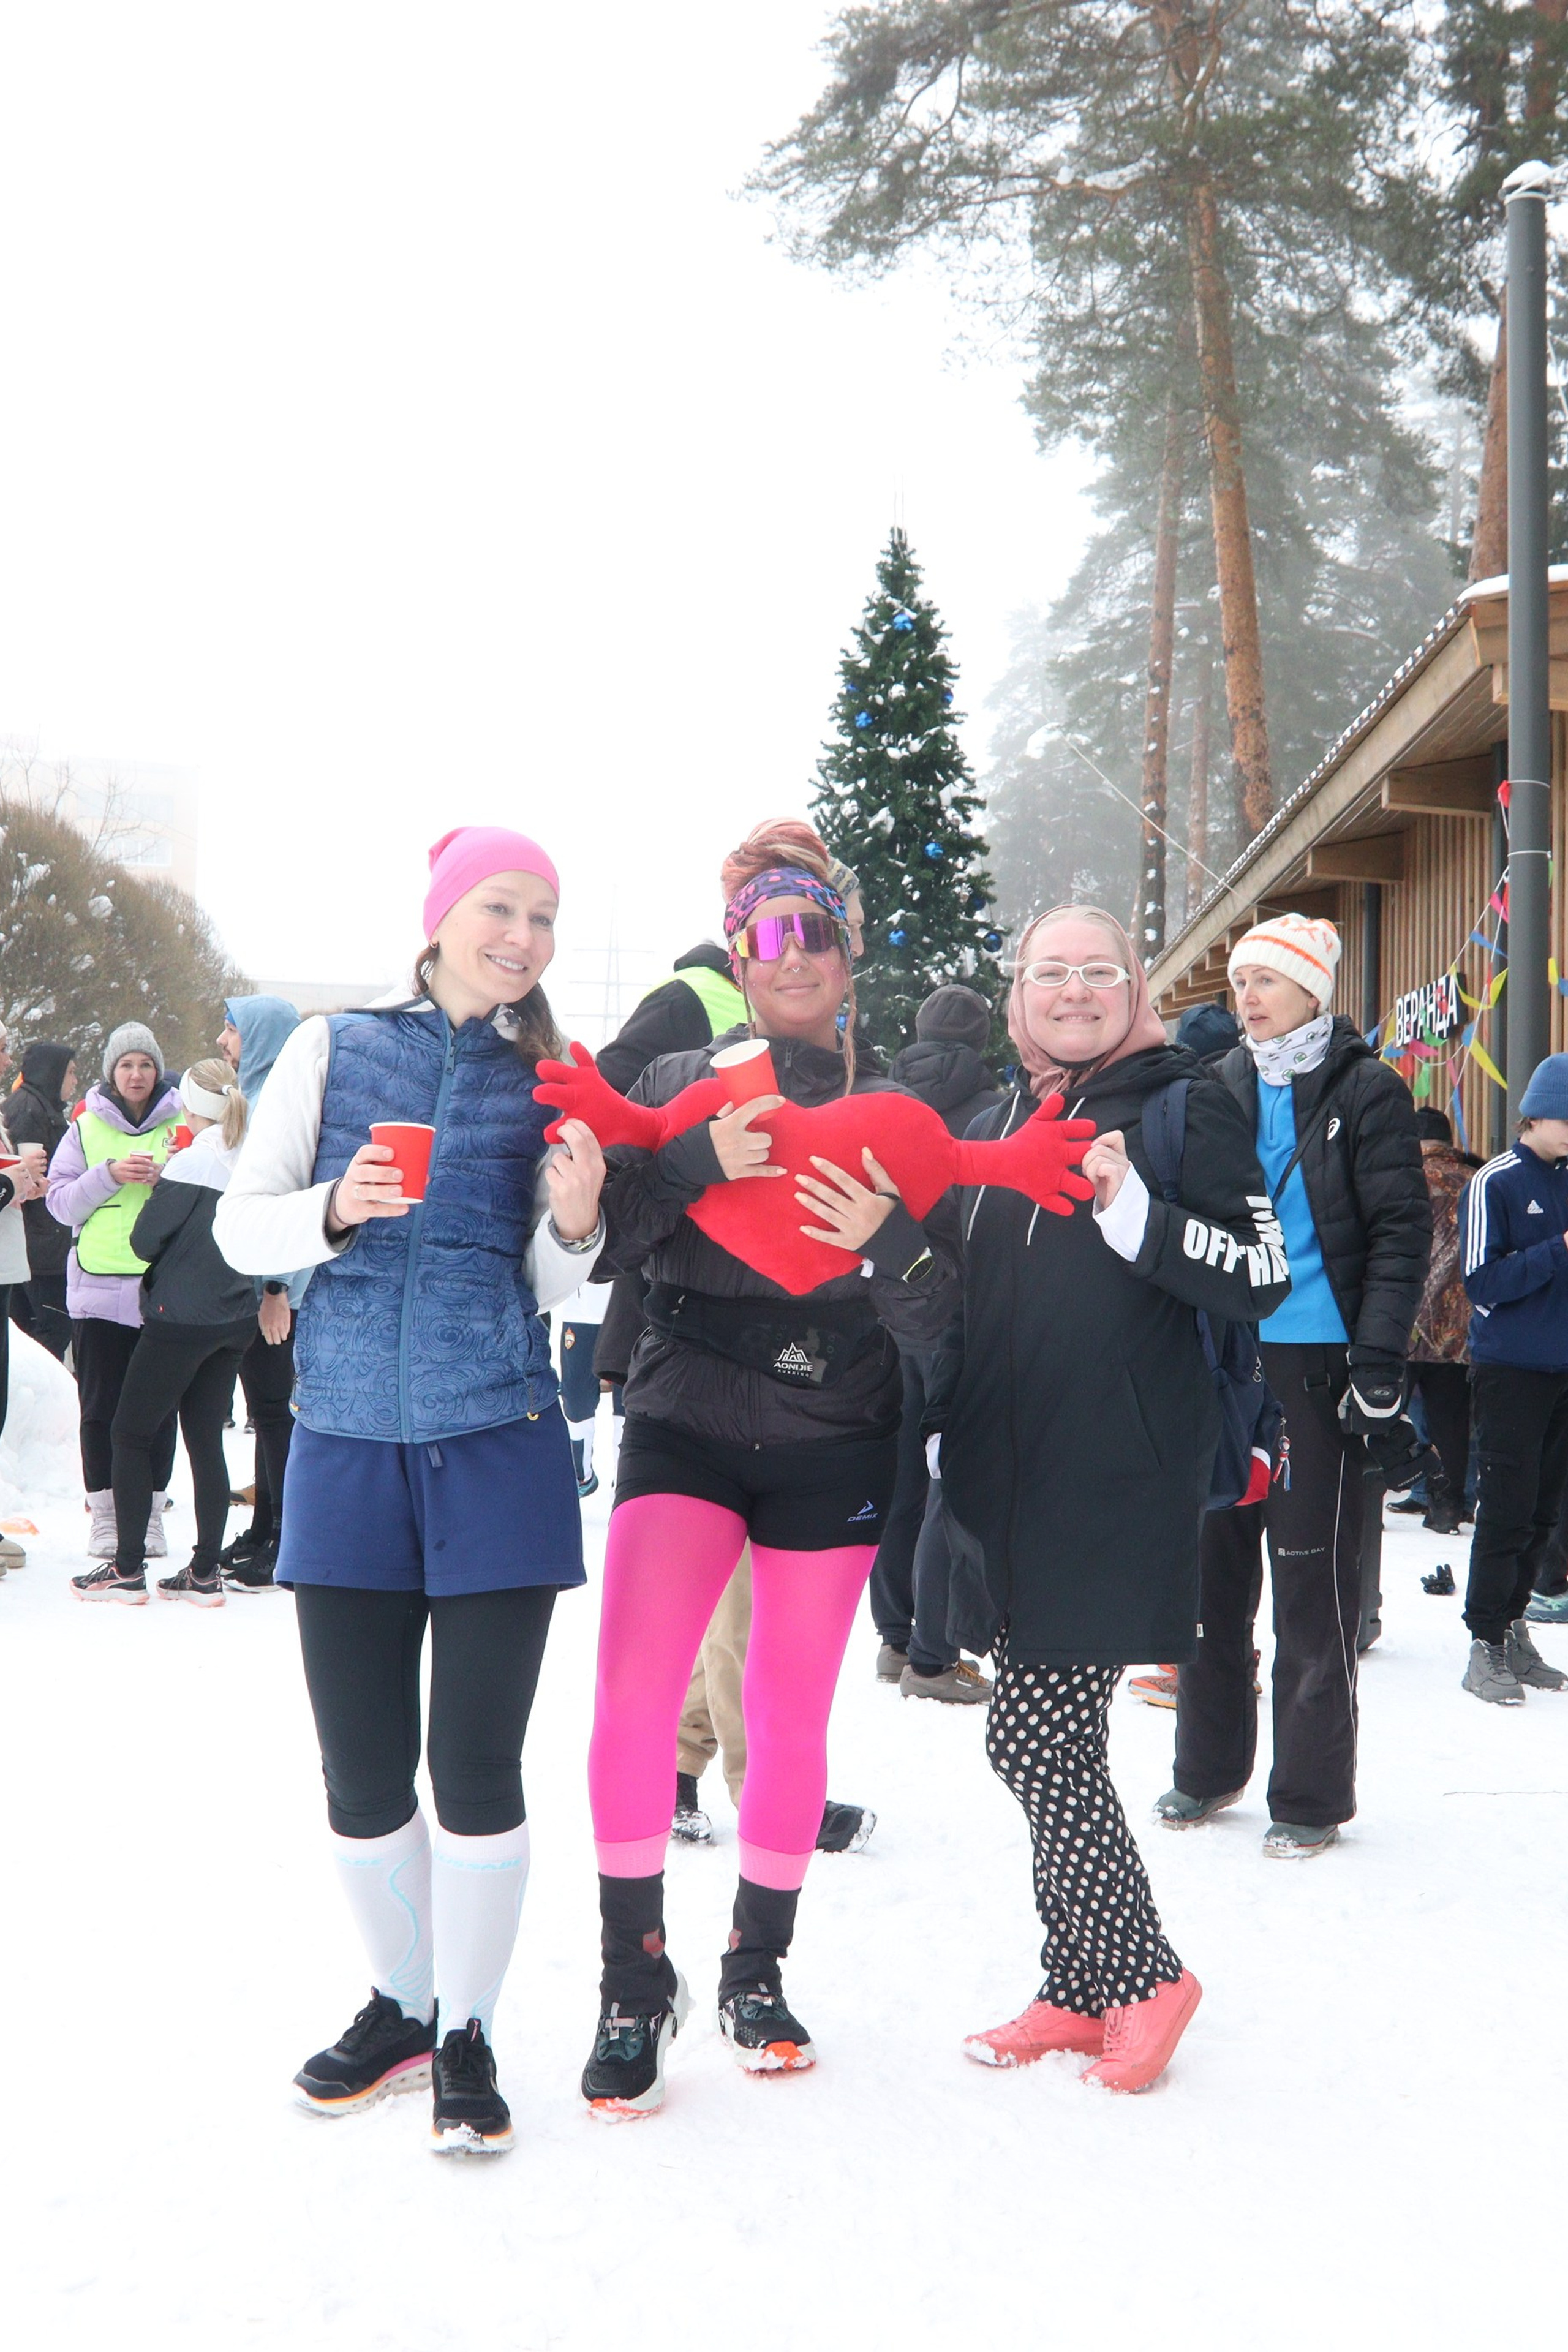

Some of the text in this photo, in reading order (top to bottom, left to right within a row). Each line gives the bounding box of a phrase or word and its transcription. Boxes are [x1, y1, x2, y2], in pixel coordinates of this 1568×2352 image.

[1396, 974, 1458, 1047] ВЕРАНДА
[774, 1362, 813, 1372] AONIJIE
[847, 1513, 878, 1522] DEMIX
